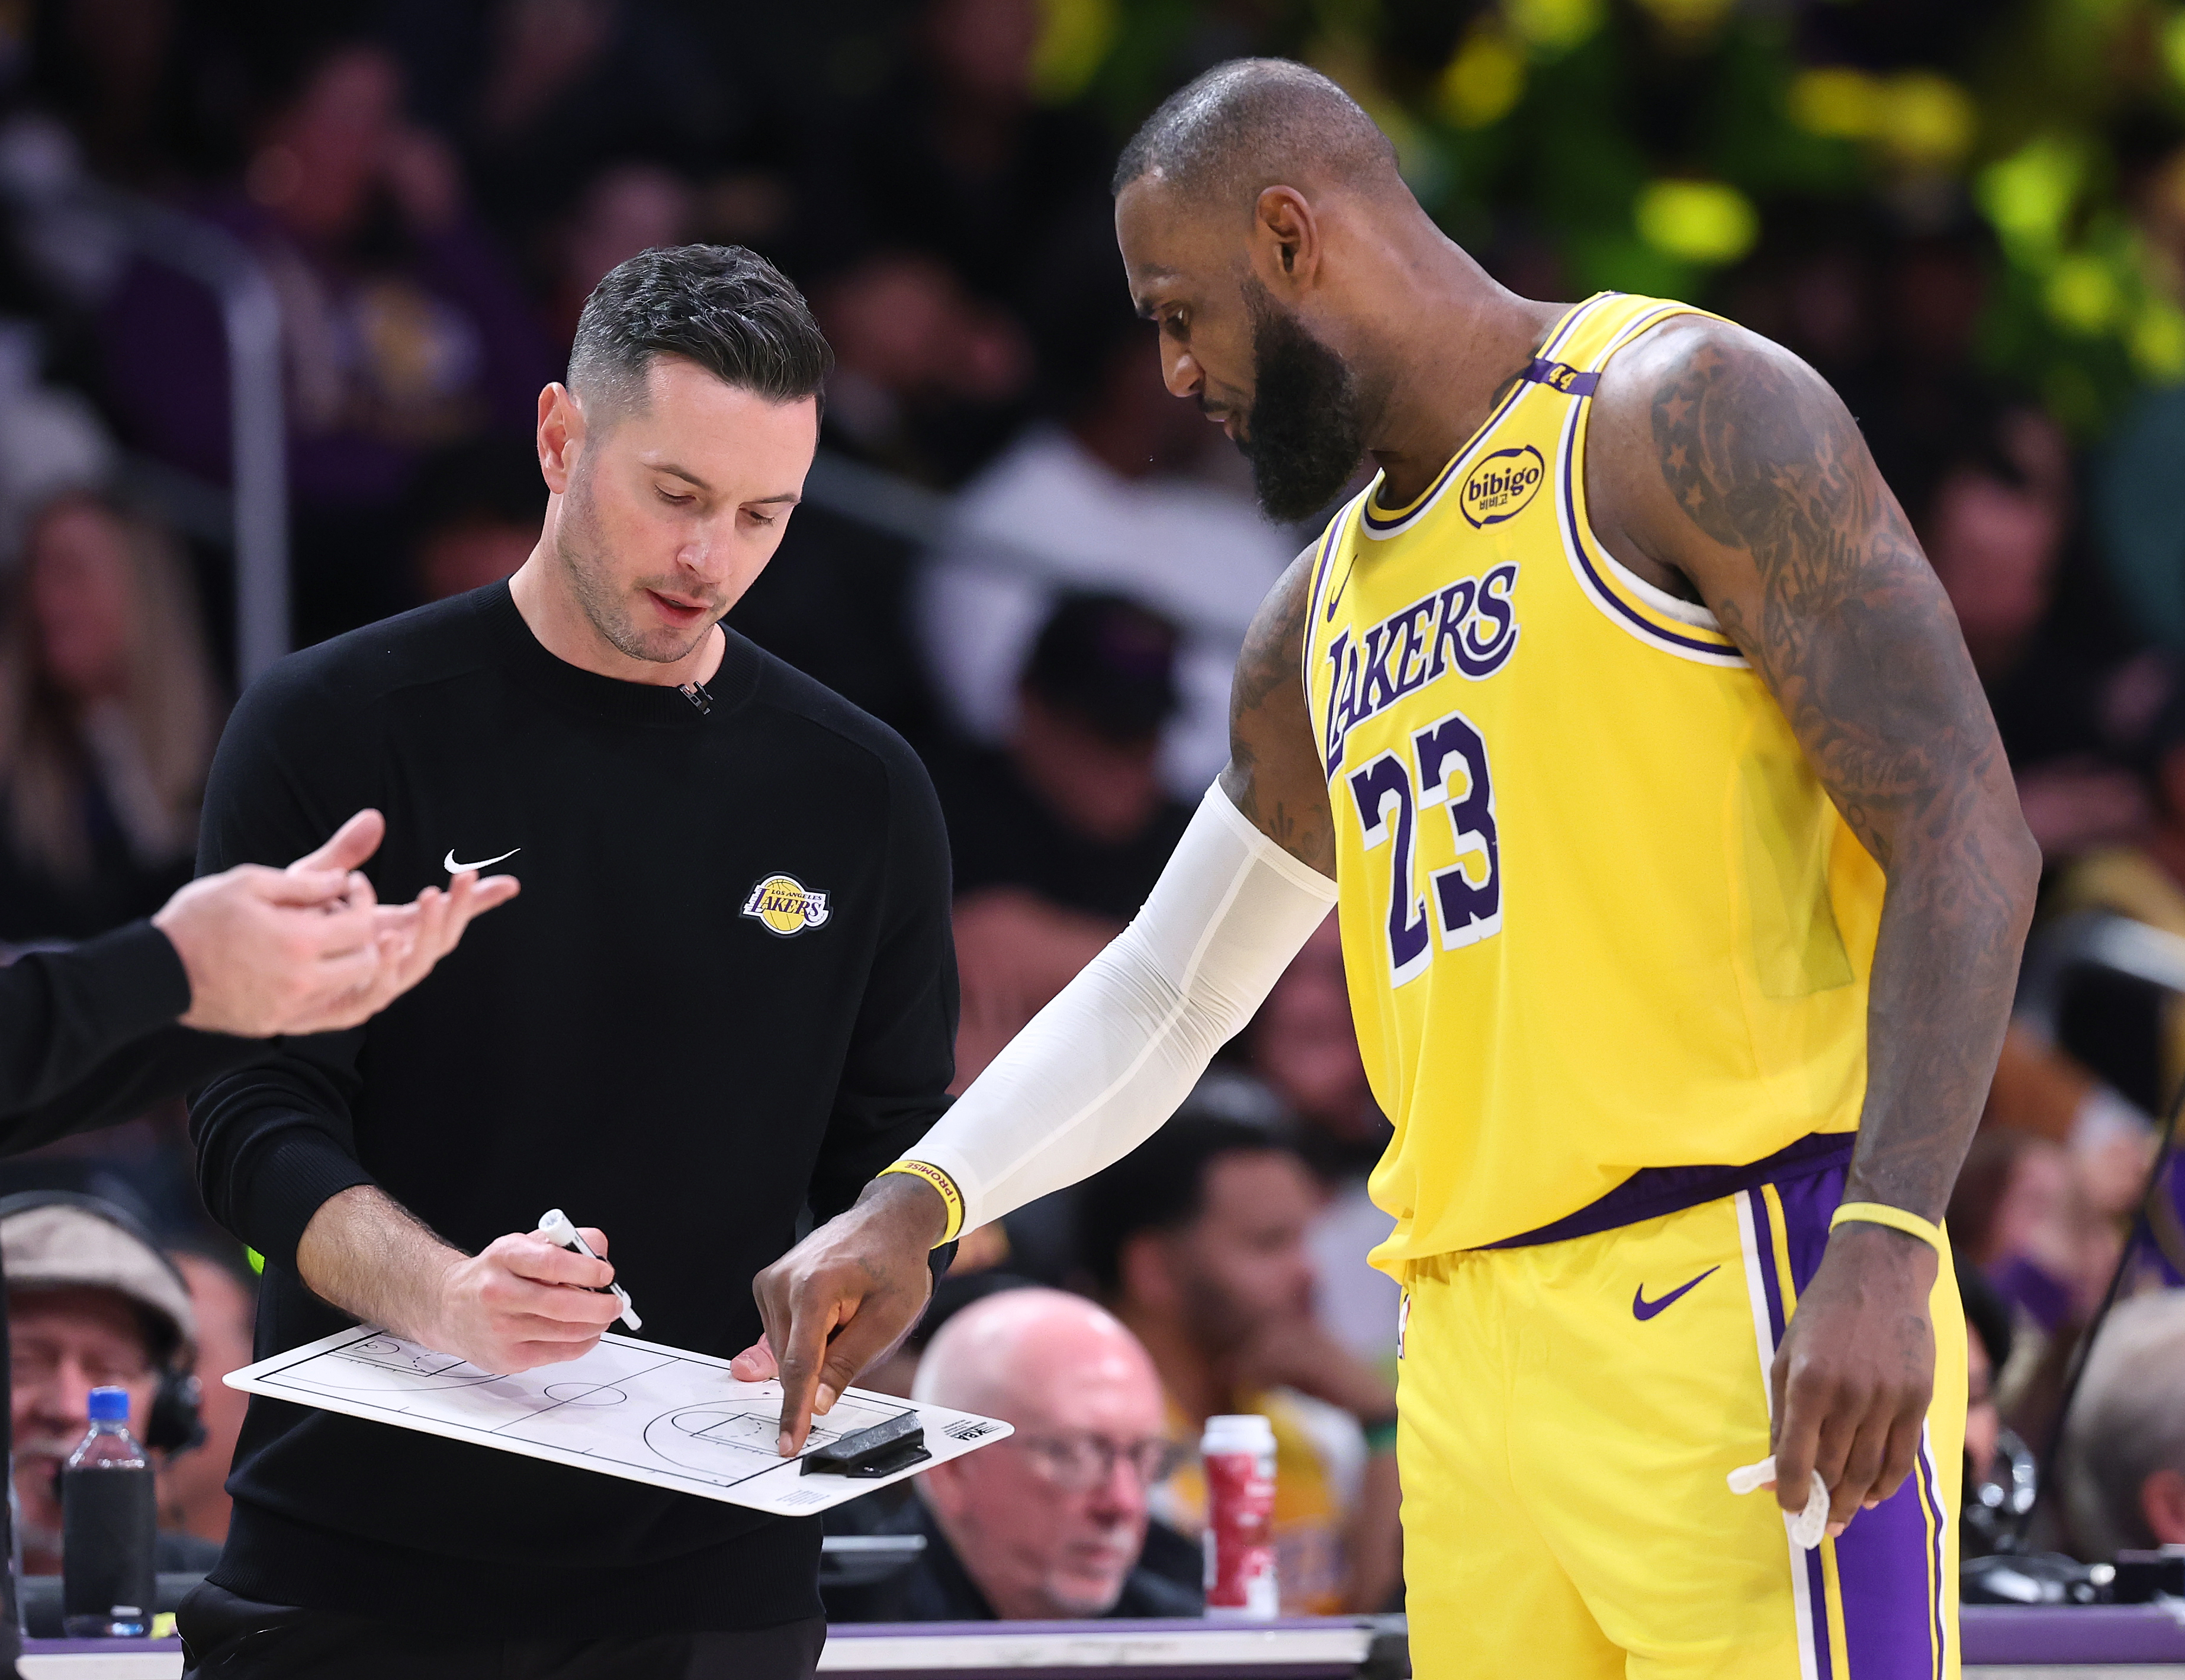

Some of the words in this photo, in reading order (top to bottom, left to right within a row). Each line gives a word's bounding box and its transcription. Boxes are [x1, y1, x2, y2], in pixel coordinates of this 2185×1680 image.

[1548, 365, 1577, 390] 44
[1469, 467, 1539, 501] bibigo
[1479, 493, 1508, 510] 비비고
[1326, 561, 1521, 786] LAKERS
[1345, 710, 1502, 989] 23
[751, 888, 824, 923] LAKERS
[786, 892, 822, 901] ANGELES
[905, 1162, 953, 1196] PROMISE
